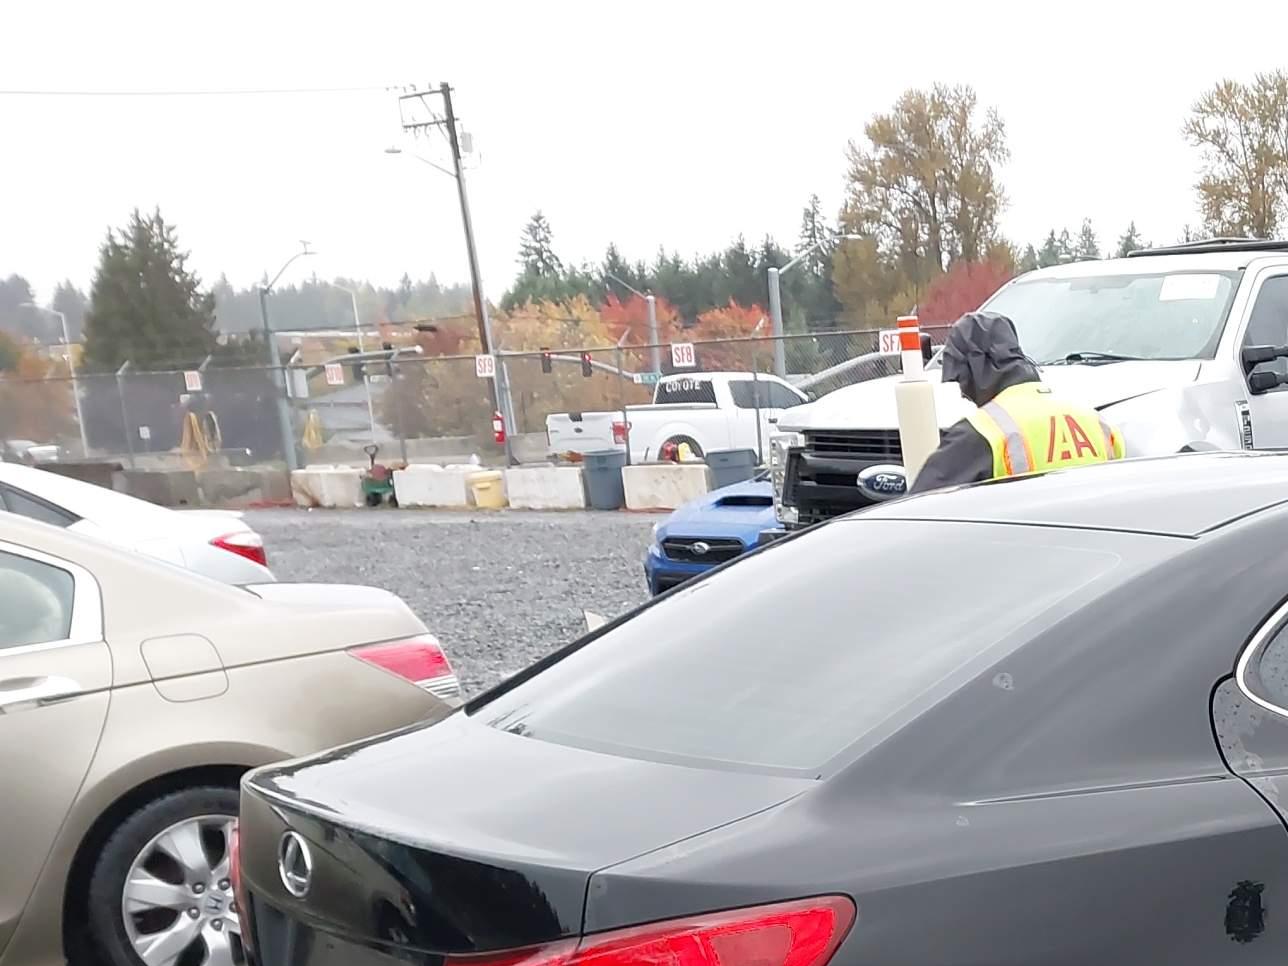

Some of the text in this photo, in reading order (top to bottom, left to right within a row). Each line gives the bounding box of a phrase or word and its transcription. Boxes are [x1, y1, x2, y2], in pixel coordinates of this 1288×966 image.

[882, 333, 900, 353] SF
[673, 346, 694, 364] SF8
[477, 357, 494, 374] SF9
[665, 380, 701, 393] COYOTE
[873, 474, 905, 491] Ford
